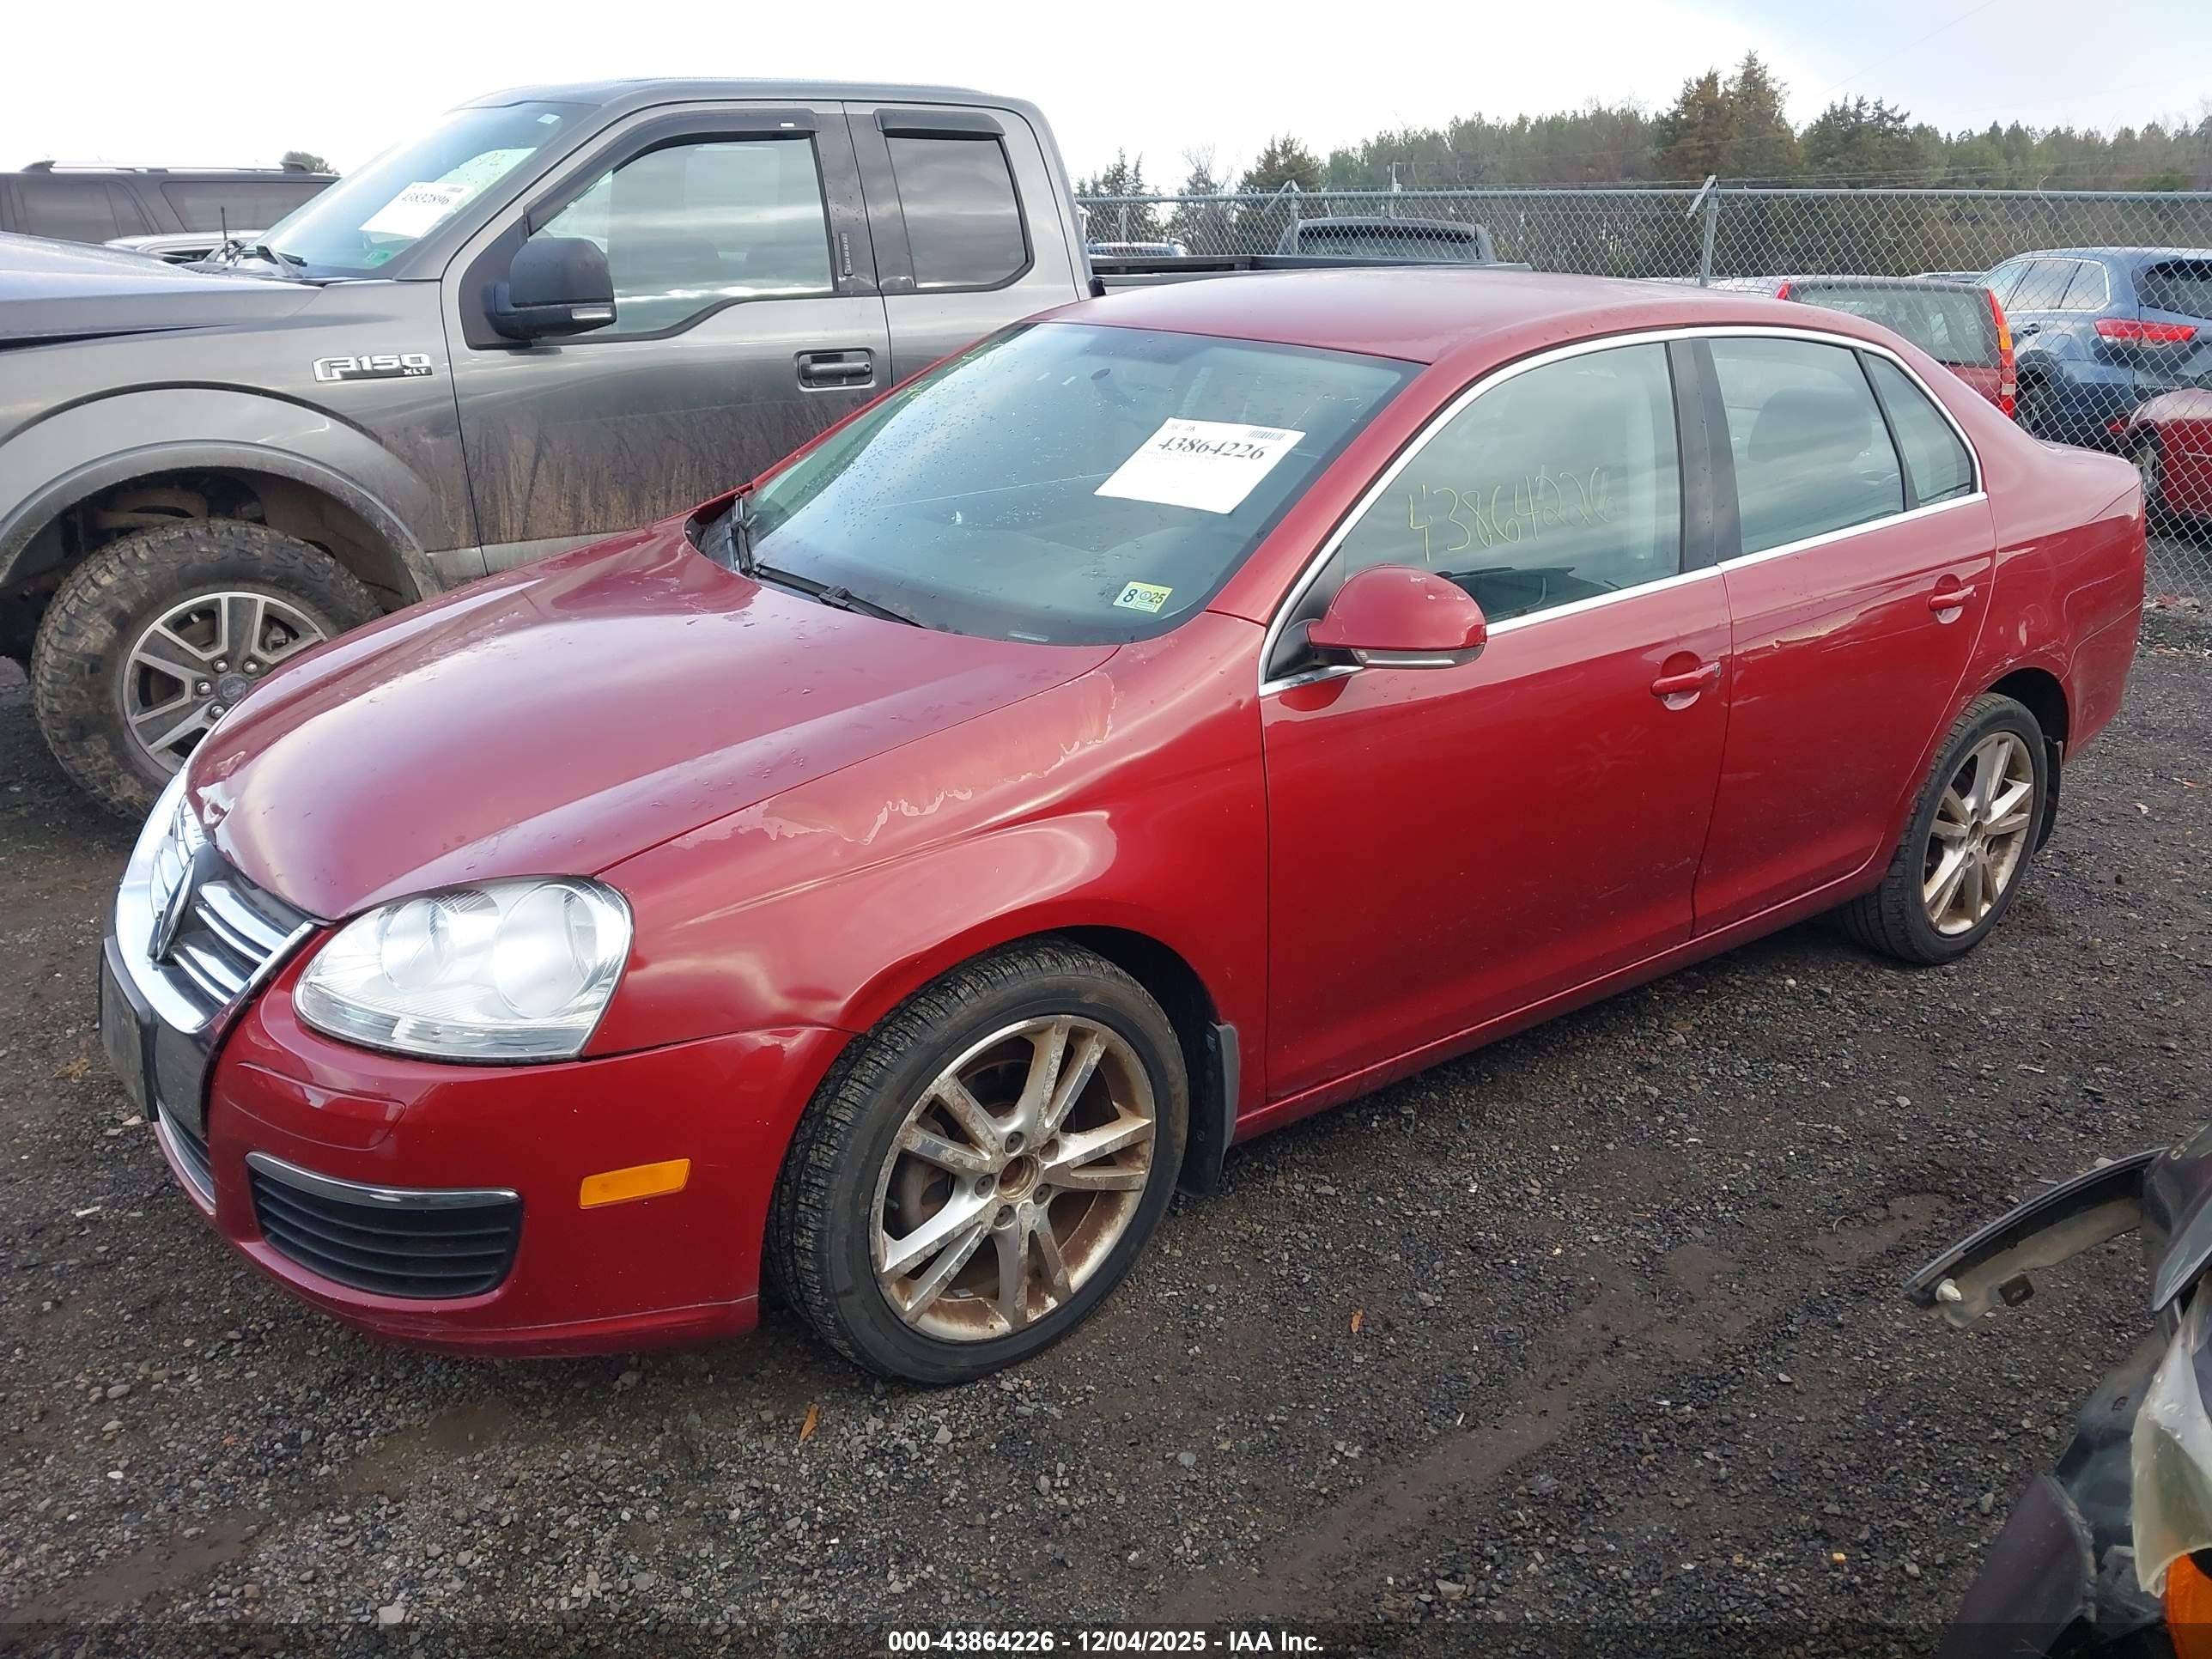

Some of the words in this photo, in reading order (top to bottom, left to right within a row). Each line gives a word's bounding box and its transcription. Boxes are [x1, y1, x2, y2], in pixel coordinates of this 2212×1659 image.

[1158, 436, 1271, 460] 43864226
[1122, 588, 1139, 603] 8
[1148, 592, 1167, 605] 25
